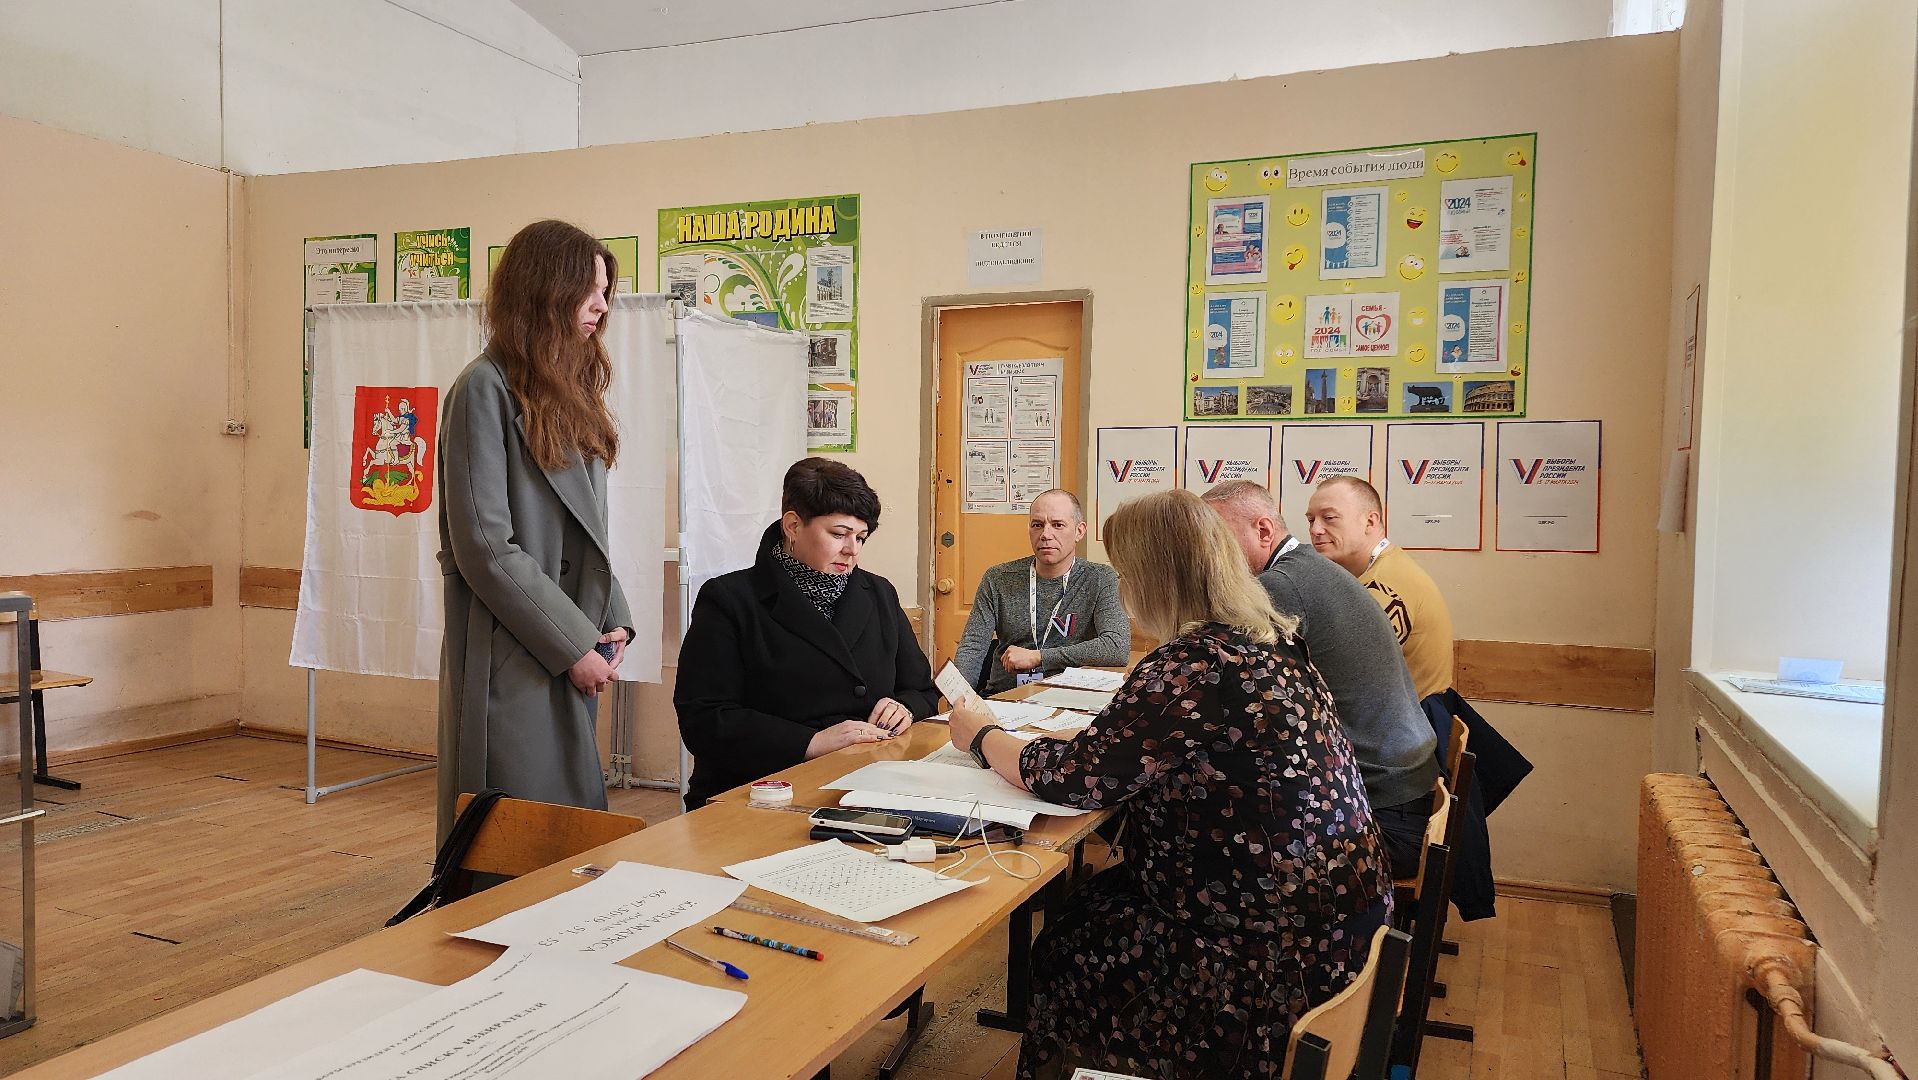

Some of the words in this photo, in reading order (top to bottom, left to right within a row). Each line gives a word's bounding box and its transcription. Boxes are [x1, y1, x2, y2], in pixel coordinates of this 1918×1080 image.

[1289, 168, 1329, 181] Время
[1330, 162, 1385, 176] события
[1387, 160, 1424, 172] люди
[1447, 197, 1471, 210] 2024
[678, 212, 742, 243] НАША
[744, 205, 837, 242] РОДИНА
[416, 233, 448, 248] УЧИСЬ
[315, 247, 328, 255] Это
[409, 252, 455, 267] УЧИТЬСЯ
[1314, 326, 1341, 335] 2024
[406, 1046, 464, 1075] СПИСКА
[462, 1002, 547, 1044] ИЗБИРАТЕЛЕЙ
